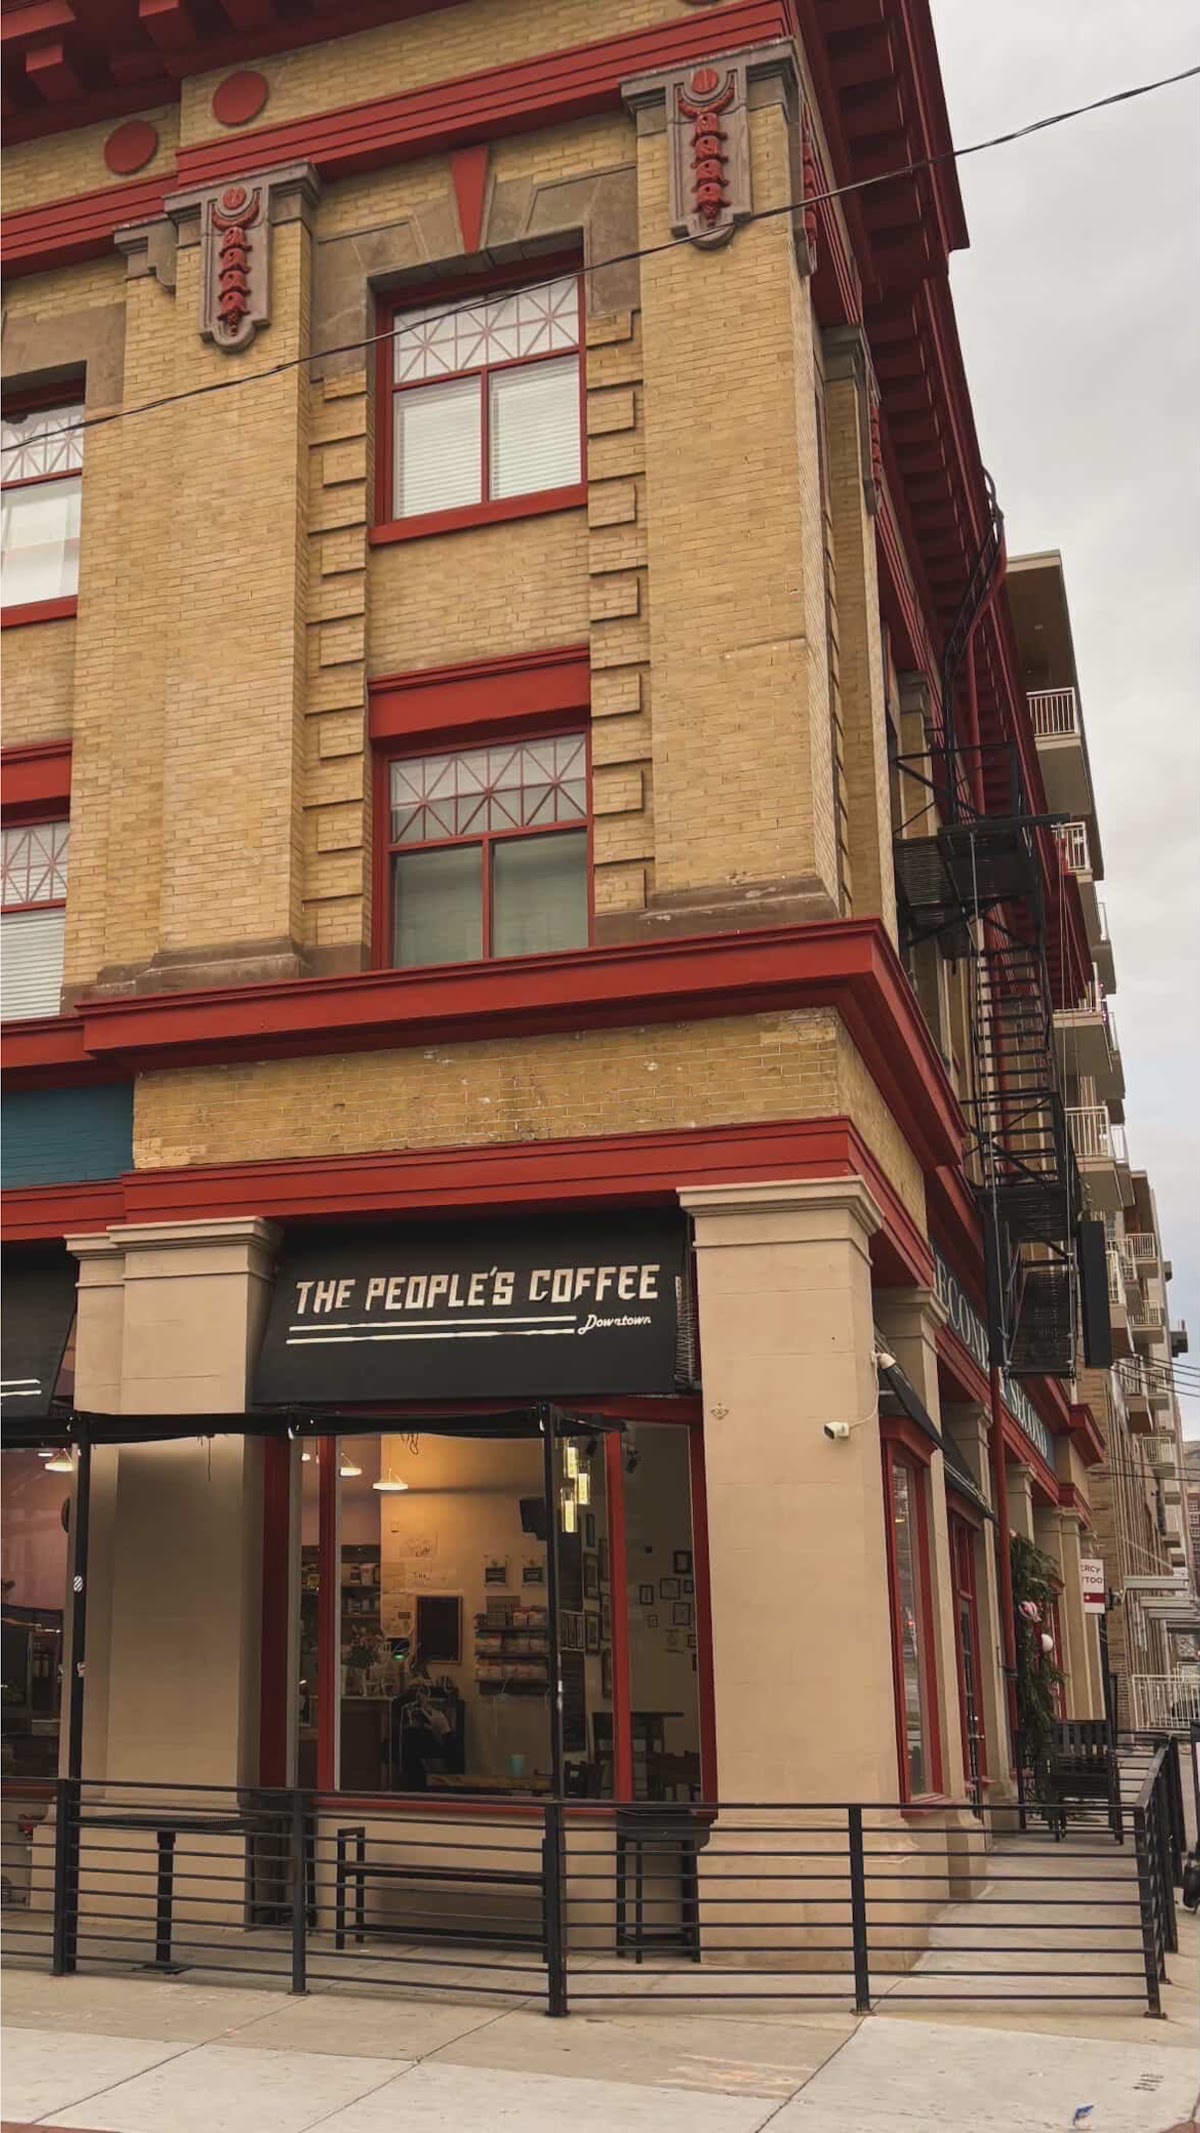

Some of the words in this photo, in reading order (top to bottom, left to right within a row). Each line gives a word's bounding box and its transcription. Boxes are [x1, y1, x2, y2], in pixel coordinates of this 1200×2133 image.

[296, 1279, 356, 1315] THE
[365, 1266, 516, 1311] PEOPLE'S
[529, 1264, 660, 1303] COFFEE
[577, 1313, 652, 1336] Downtown
